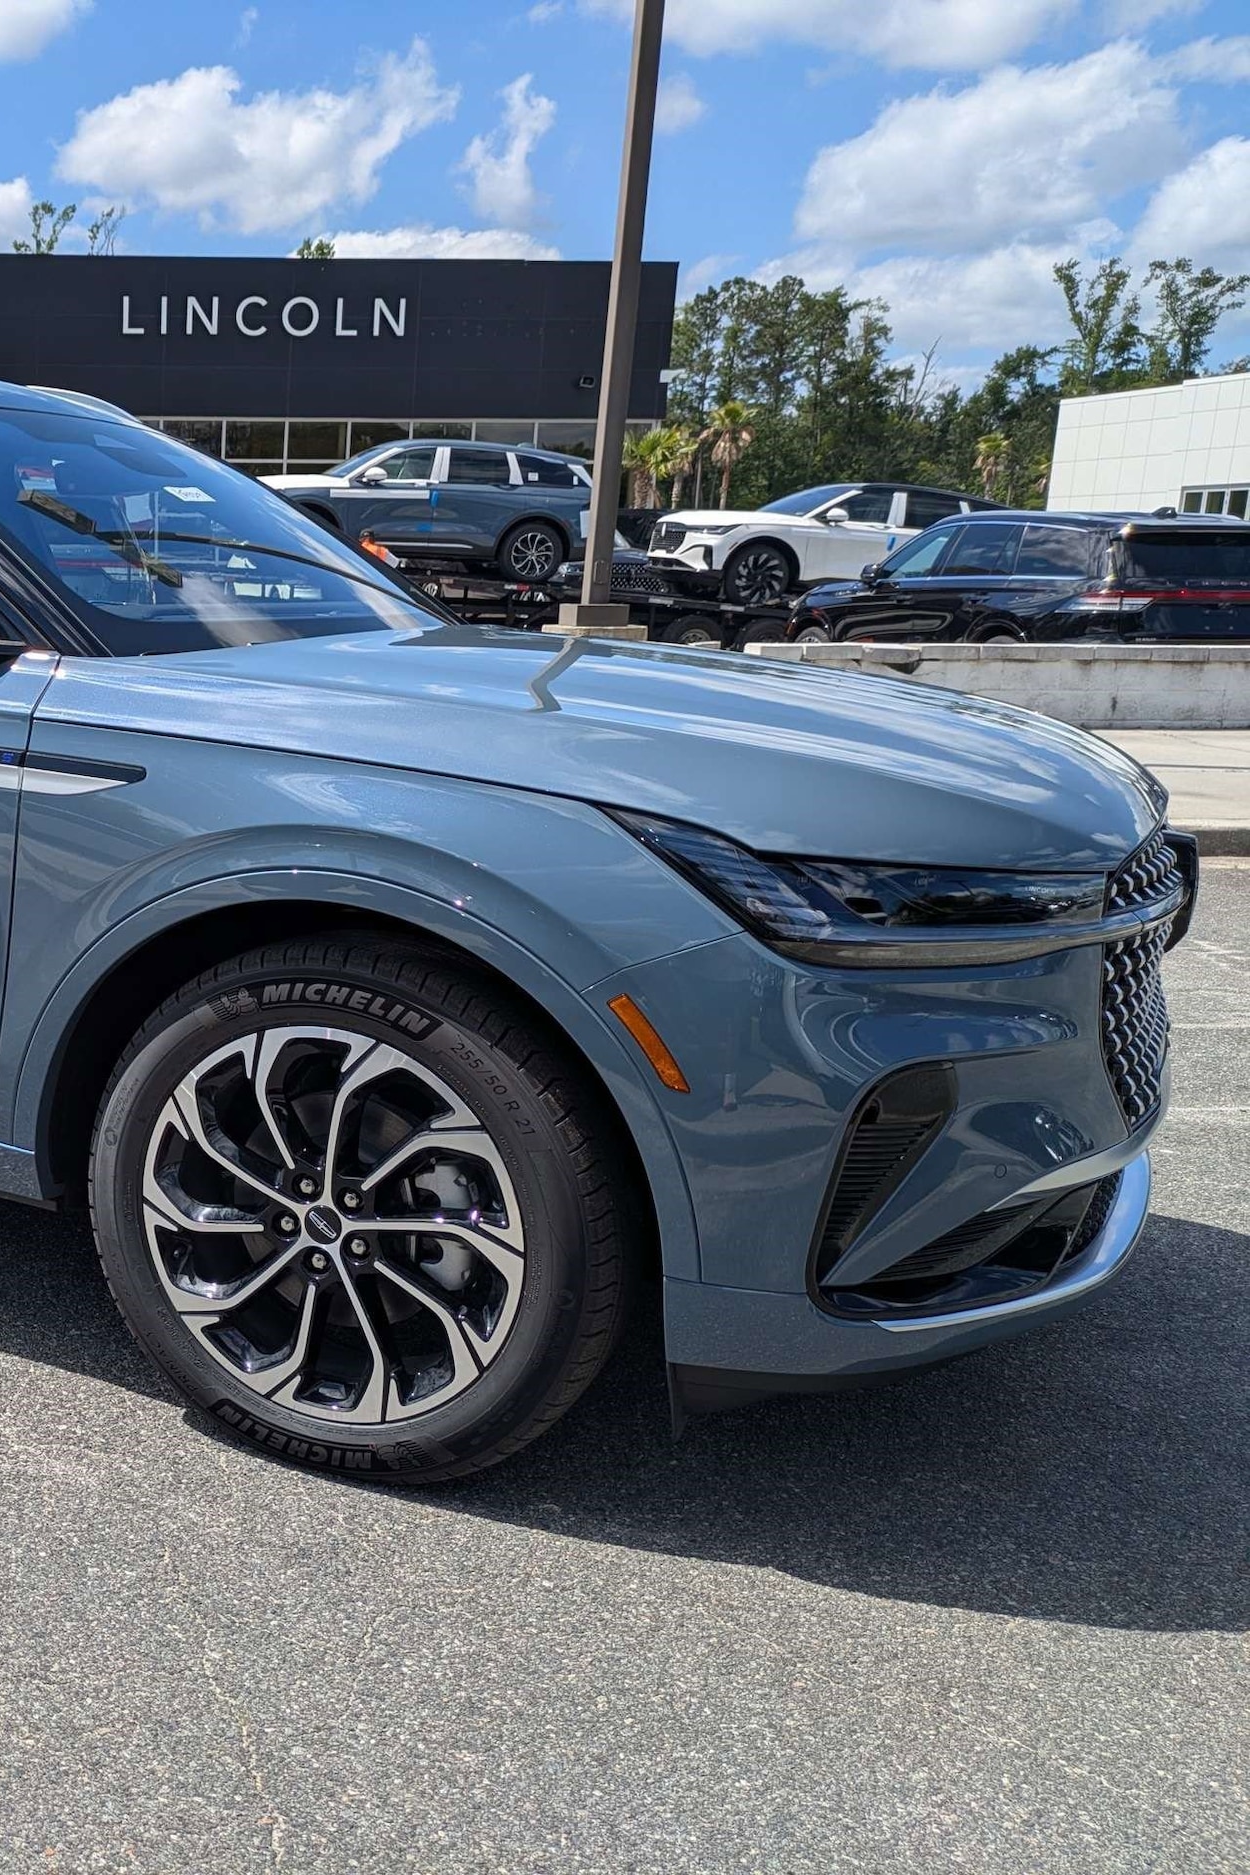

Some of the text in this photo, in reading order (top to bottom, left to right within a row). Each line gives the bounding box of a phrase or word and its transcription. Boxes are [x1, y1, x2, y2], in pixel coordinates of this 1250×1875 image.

[121, 294, 408, 337] LINCOLN
[262, 982, 432, 1035] MICHELIN
[450, 1041, 508, 1096] 255/50
[504, 1100, 521, 1114] R
[515, 1118, 537, 1136] 21
[216, 1403, 372, 1469] MICHELIN
